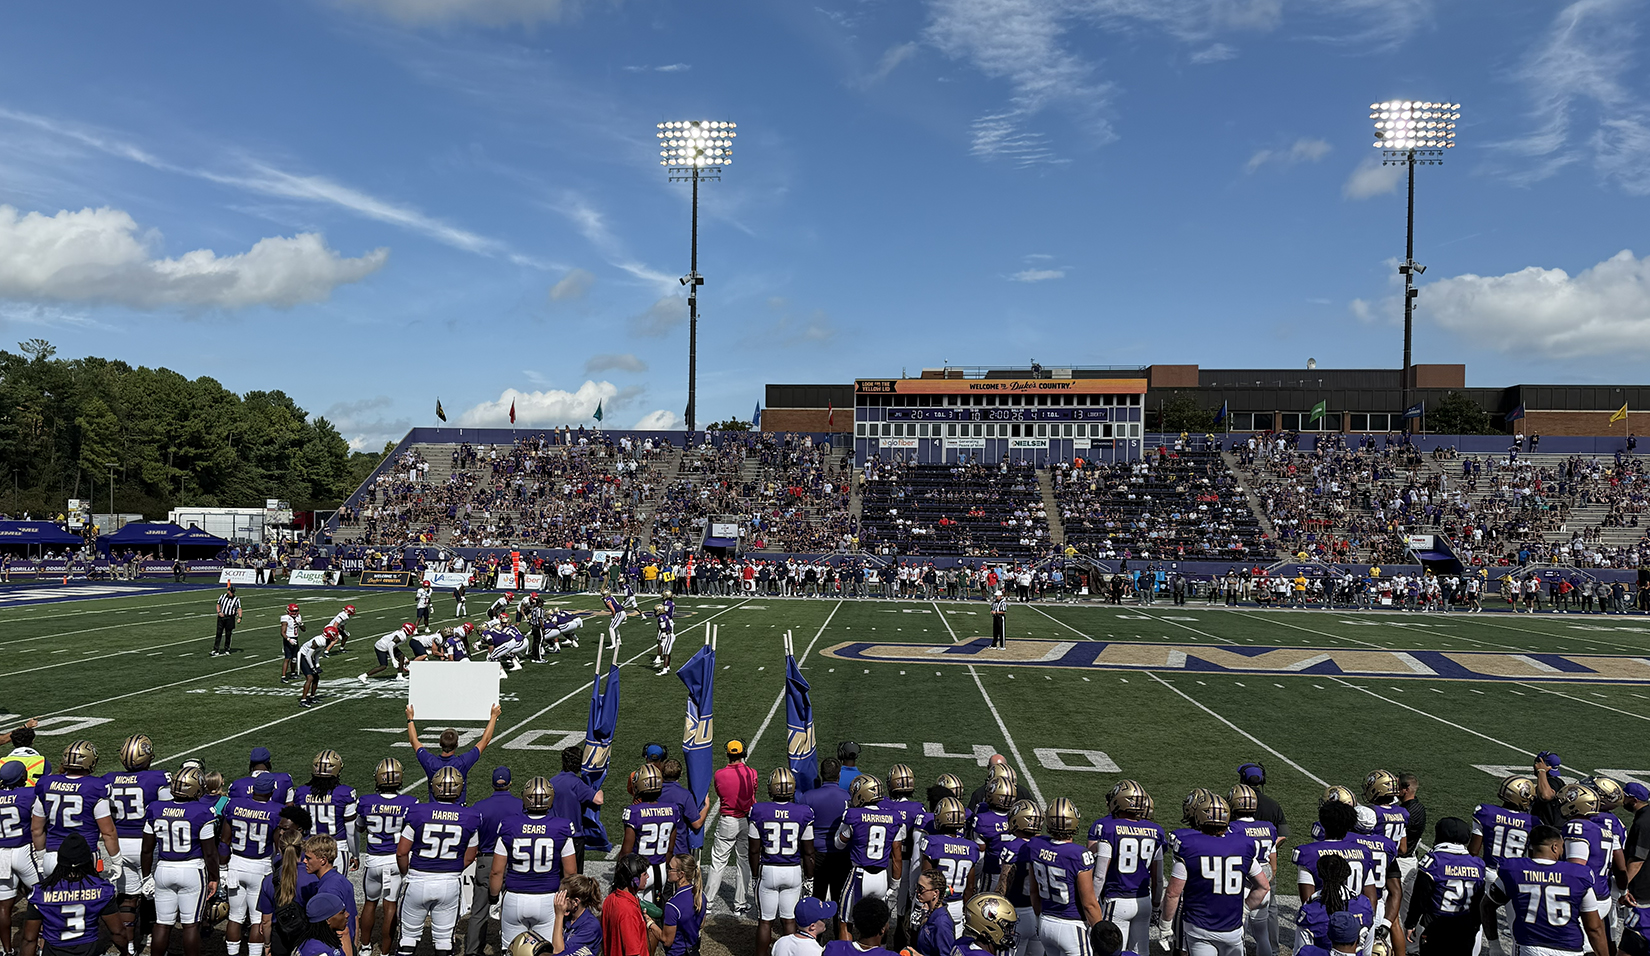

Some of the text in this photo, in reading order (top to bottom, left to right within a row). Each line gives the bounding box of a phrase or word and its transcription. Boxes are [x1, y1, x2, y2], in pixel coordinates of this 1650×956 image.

[1010, 381, 1036, 392] Duke's
[911, 410, 923, 419] 20
[971, 412, 981, 421] 10
[989, 410, 1010, 420] 2:00
[1012, 412, 1025, 421] 26
[1074, 410, 1084, 420] 13
[49, 781, 82, 793] MASSEY
[114, 775, 138, 785] MICHEL
[45, 793, 84, 829] 72
[162, 807, 186, 819] SIMON
[233, 806, 271, 822] CROMWELL
[371, 804, 402, 815] K. SMITH
[431, 810, 459, 822] HARRIS
[640, 806, 674, 818] MATTHEWS
[774, 810, 790, 820] DYE
[861, 812, 894, 825] HARRISON
[1496, 814, 1526, 829] BILLIOT
[153, 818, 192, 854] 90
[231, 818, 270, 855] 34
[366, 815, 404, 845] 24
[522, 824, 547, 836] SEARS
[1115, 824, 1158, 840] GUILLEMETTE
[1244, 826, 1272, 838] HERMAN
[1567, 822, 1583, 836] 75
[418, 822, 463, 861] 52
[638, 822, 675, 856] 28
[763, 821, 800, 855] 33
[866, 825, 887, 861] 8
[1491, 825, 1529, 860] 18
[511, 837, 555, 873] 50
[944, 842, 970, 857] BURNEY
[1039, 847, 1058, 862] POST
[1117, 837, 1157, 874] 89
[1081, 850, 1096, 867] 85
[1418, 853, 1434, 870] 21
[937, 857, 974, 894] 30
[1200, 855, 1244, 896] 46
[1444, 865, 1480, 878] McCARTER
[1523, 869, 1562, 885] TINILAU
[1032, 862, 1070, 905] 85
[43, 888, 103, 904] WEATHERSBY
[1517, 883, 1572, 928] 76
[60, 903, 87, 942] 3
